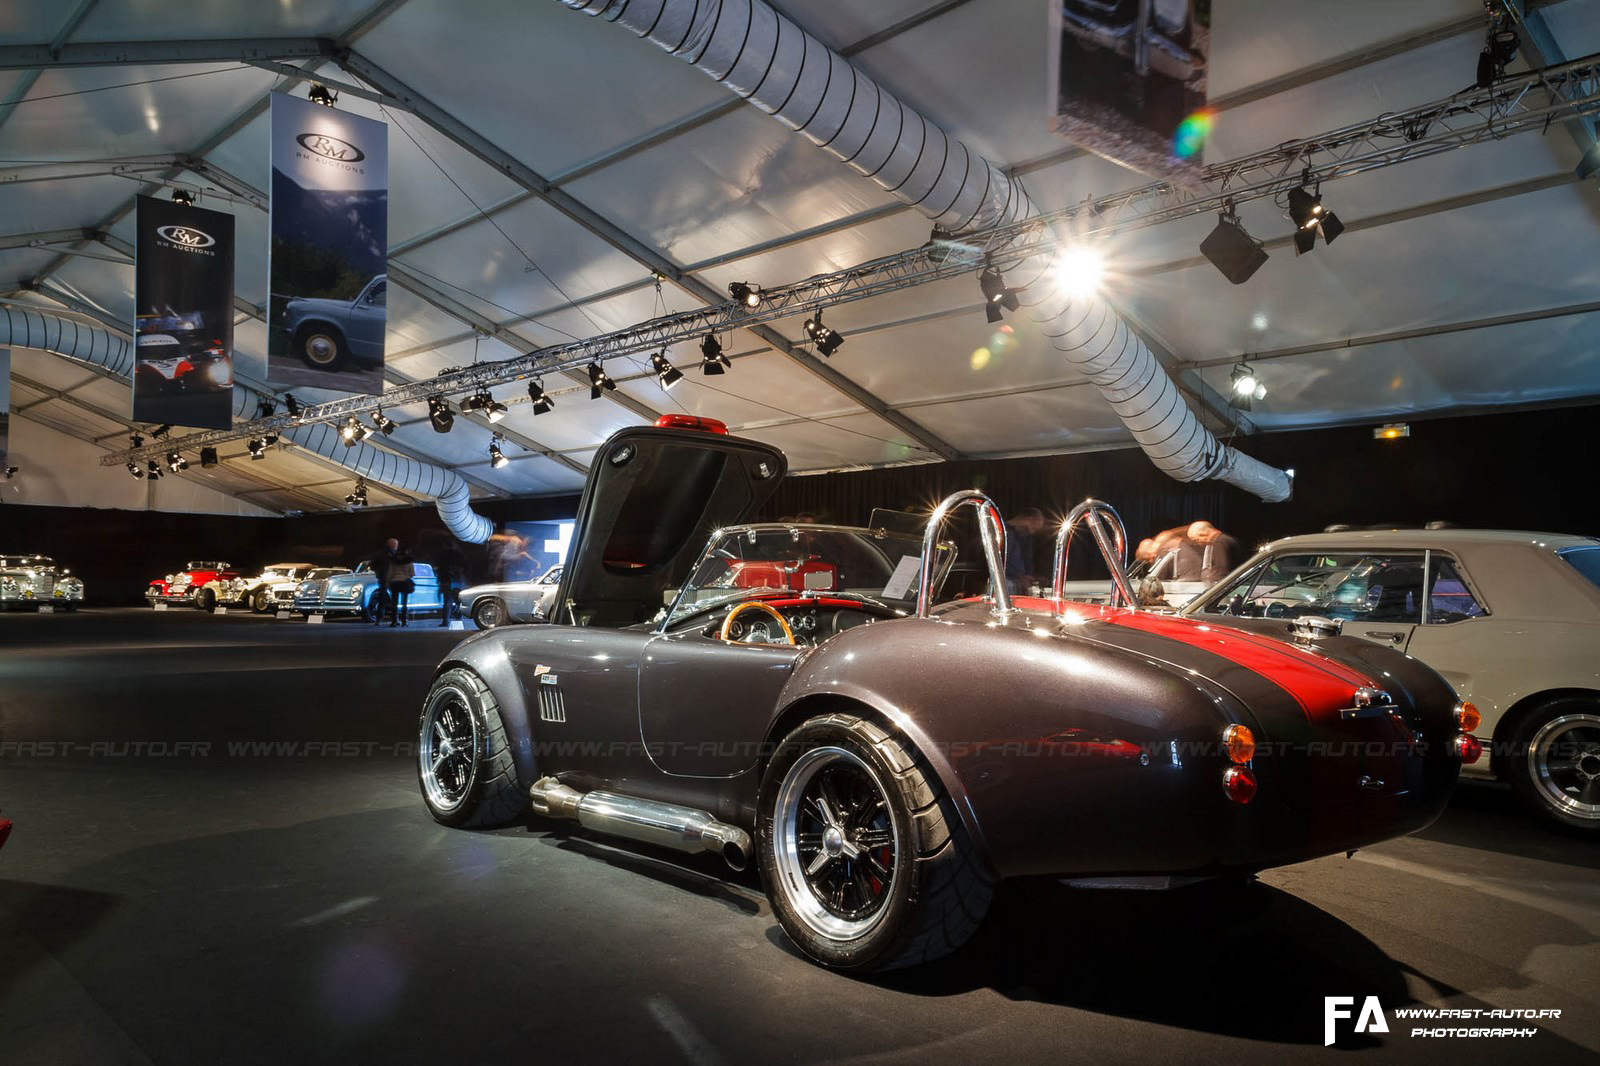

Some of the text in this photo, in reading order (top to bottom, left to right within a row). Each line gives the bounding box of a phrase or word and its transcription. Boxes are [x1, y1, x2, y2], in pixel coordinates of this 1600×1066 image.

[312, 136, 348, 159] RM
[295, 151, 365, 175] RM AUCTIONS
[170, 228, 201, 245] RM
[156, 240, 216, 257] RM AUCTIONS
